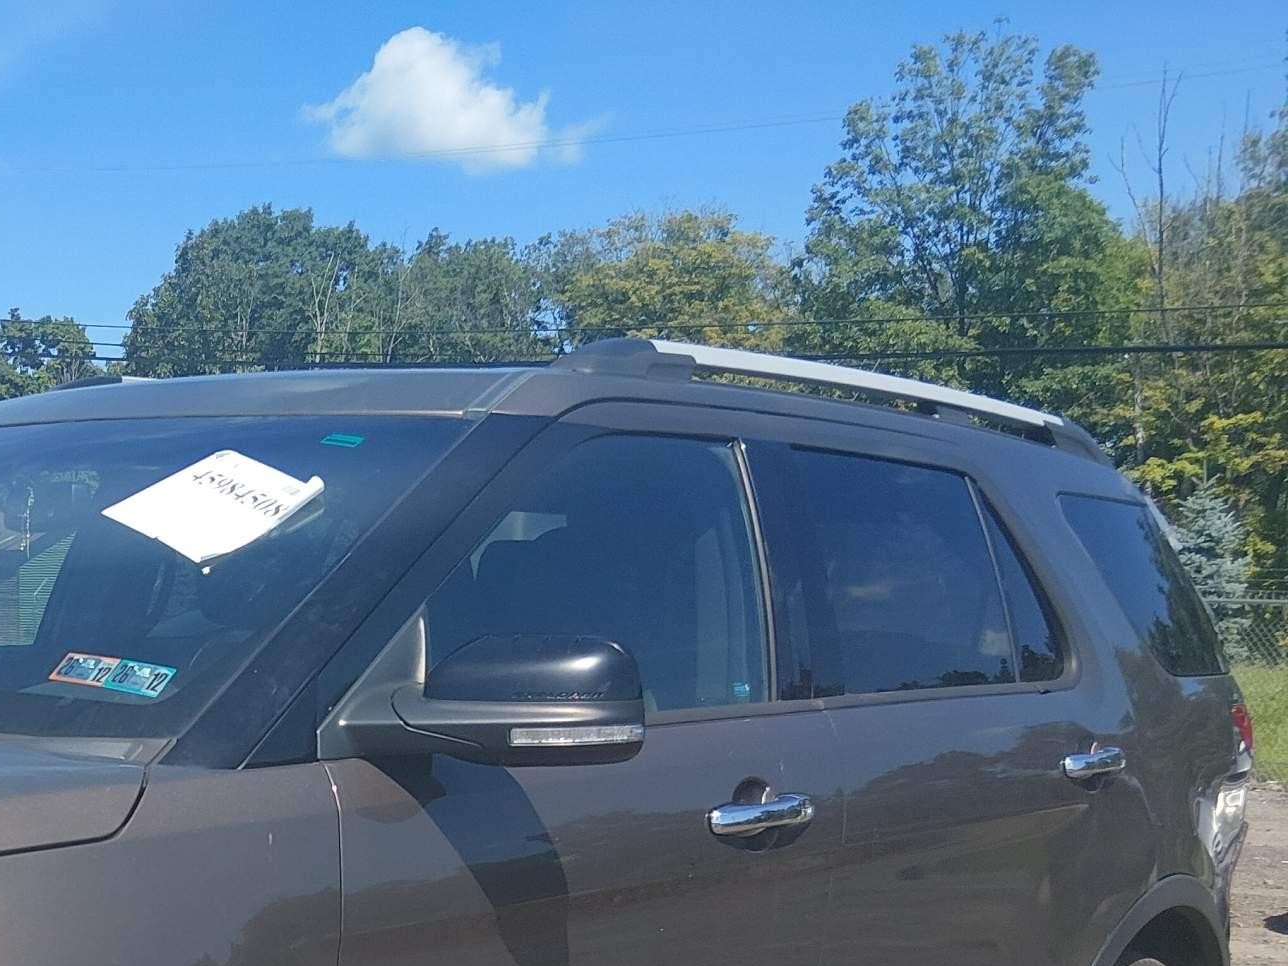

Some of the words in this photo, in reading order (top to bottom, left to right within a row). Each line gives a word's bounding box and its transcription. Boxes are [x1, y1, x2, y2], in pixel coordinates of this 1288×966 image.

[192, 470, 290, 517] 45984508
[91, 666, 113, 684] 12
[113, 663, 135, 684] 26
[145, 671, 169, 693] 12
